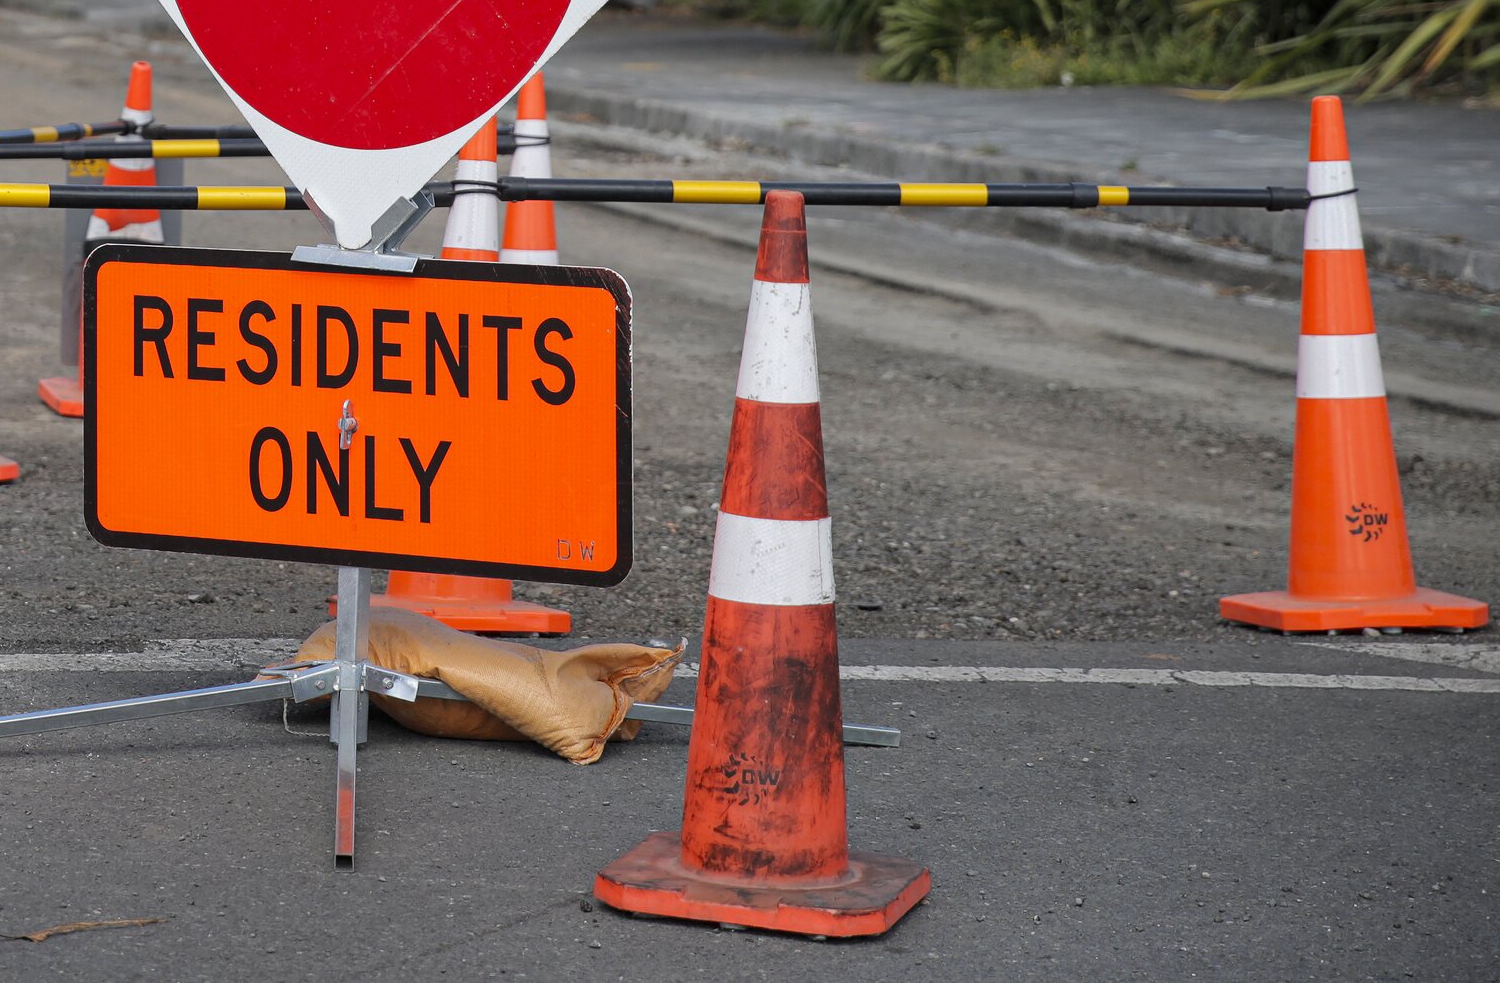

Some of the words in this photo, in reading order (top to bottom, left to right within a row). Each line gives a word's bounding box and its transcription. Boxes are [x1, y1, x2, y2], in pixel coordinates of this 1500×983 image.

[133, 294, 576, 406] RESIDENTS
[249, 426, 452, 524] ONLY
[1363, 513, 1388, 526] DW
[741, 769, 780, 785] DW
